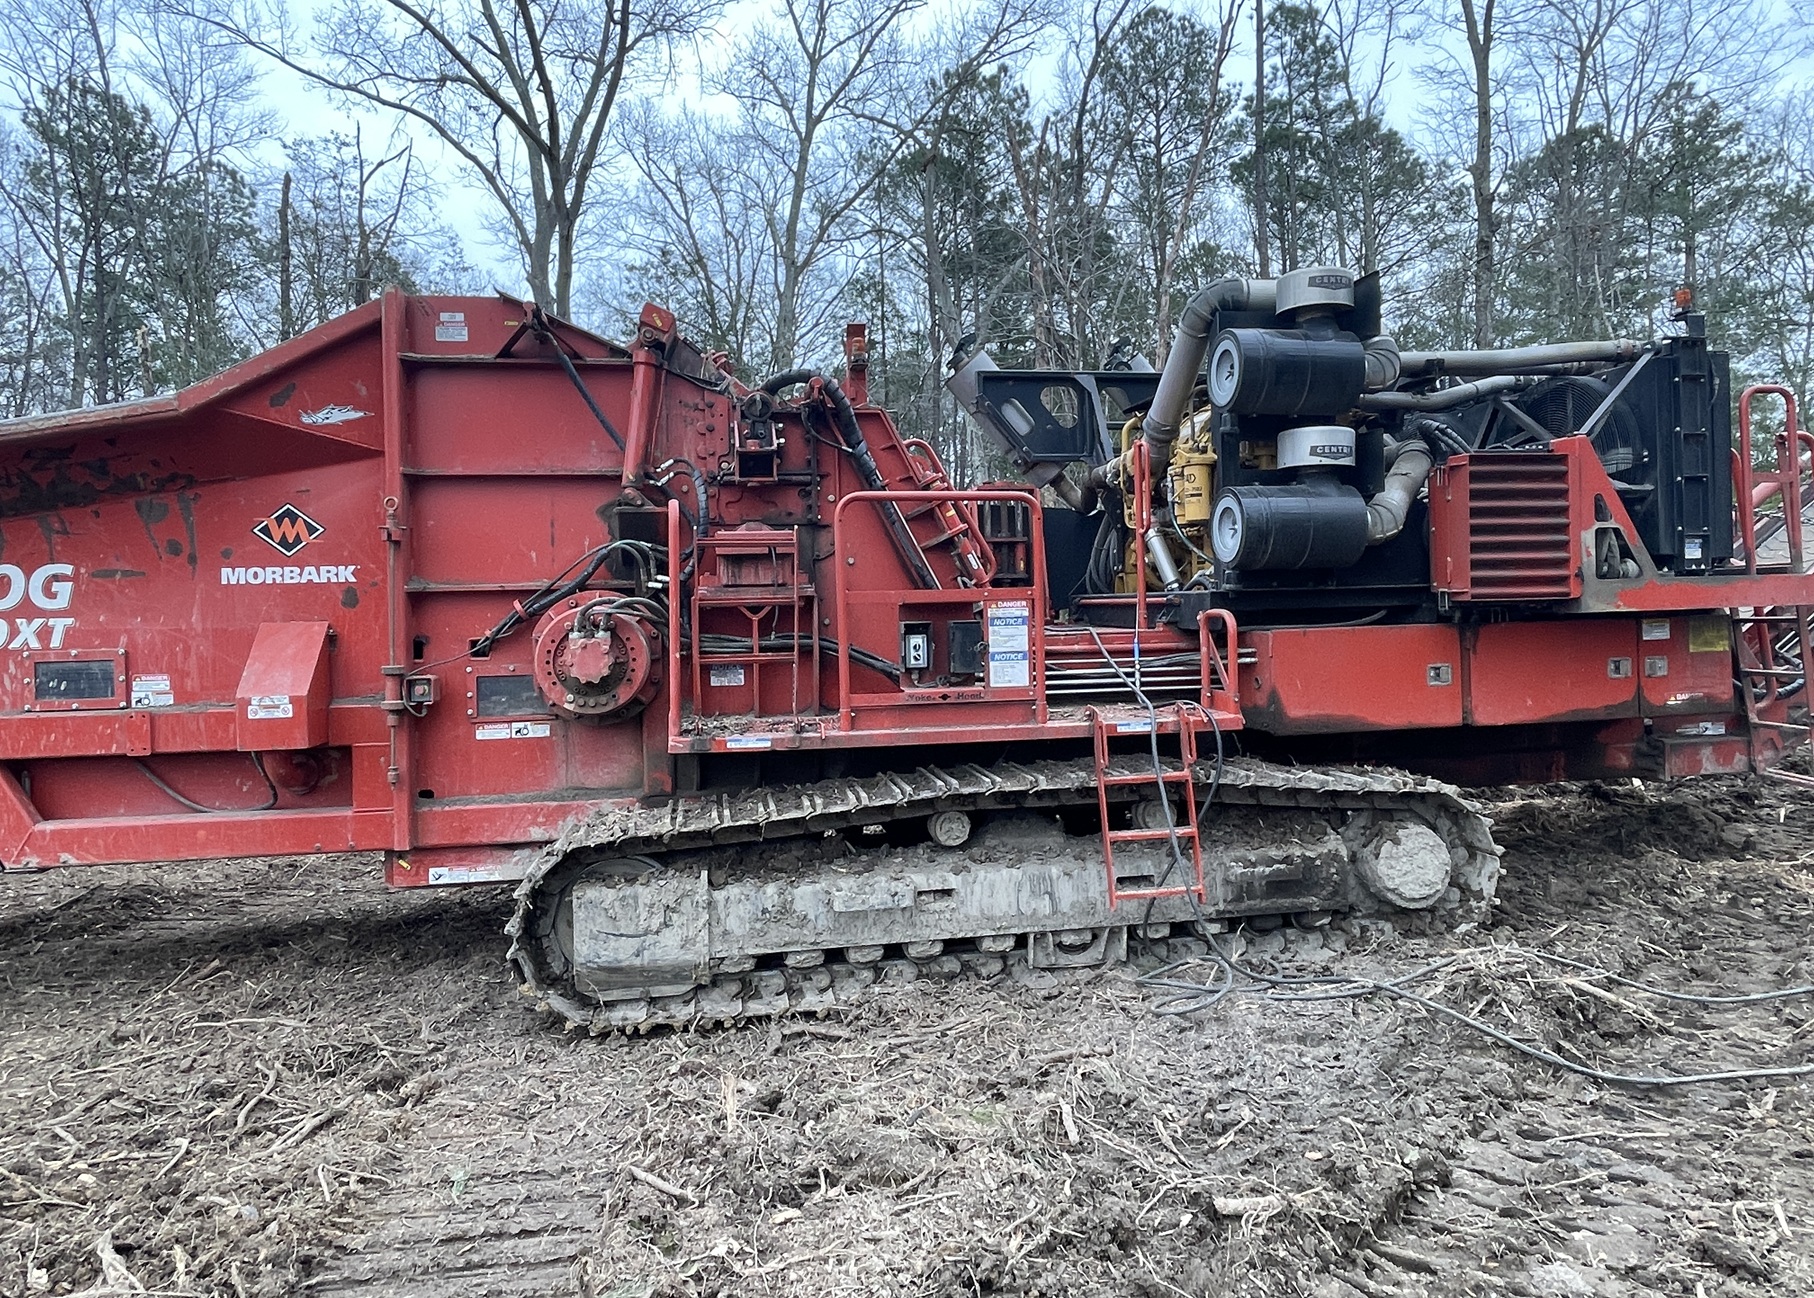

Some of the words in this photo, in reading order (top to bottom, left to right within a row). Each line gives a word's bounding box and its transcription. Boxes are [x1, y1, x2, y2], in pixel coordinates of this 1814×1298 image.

[221, 565, 357, 585] MORBARK
[993, 618, 1023, 626] NOTICE
[994, 653, 1024, 661] NOTICE
